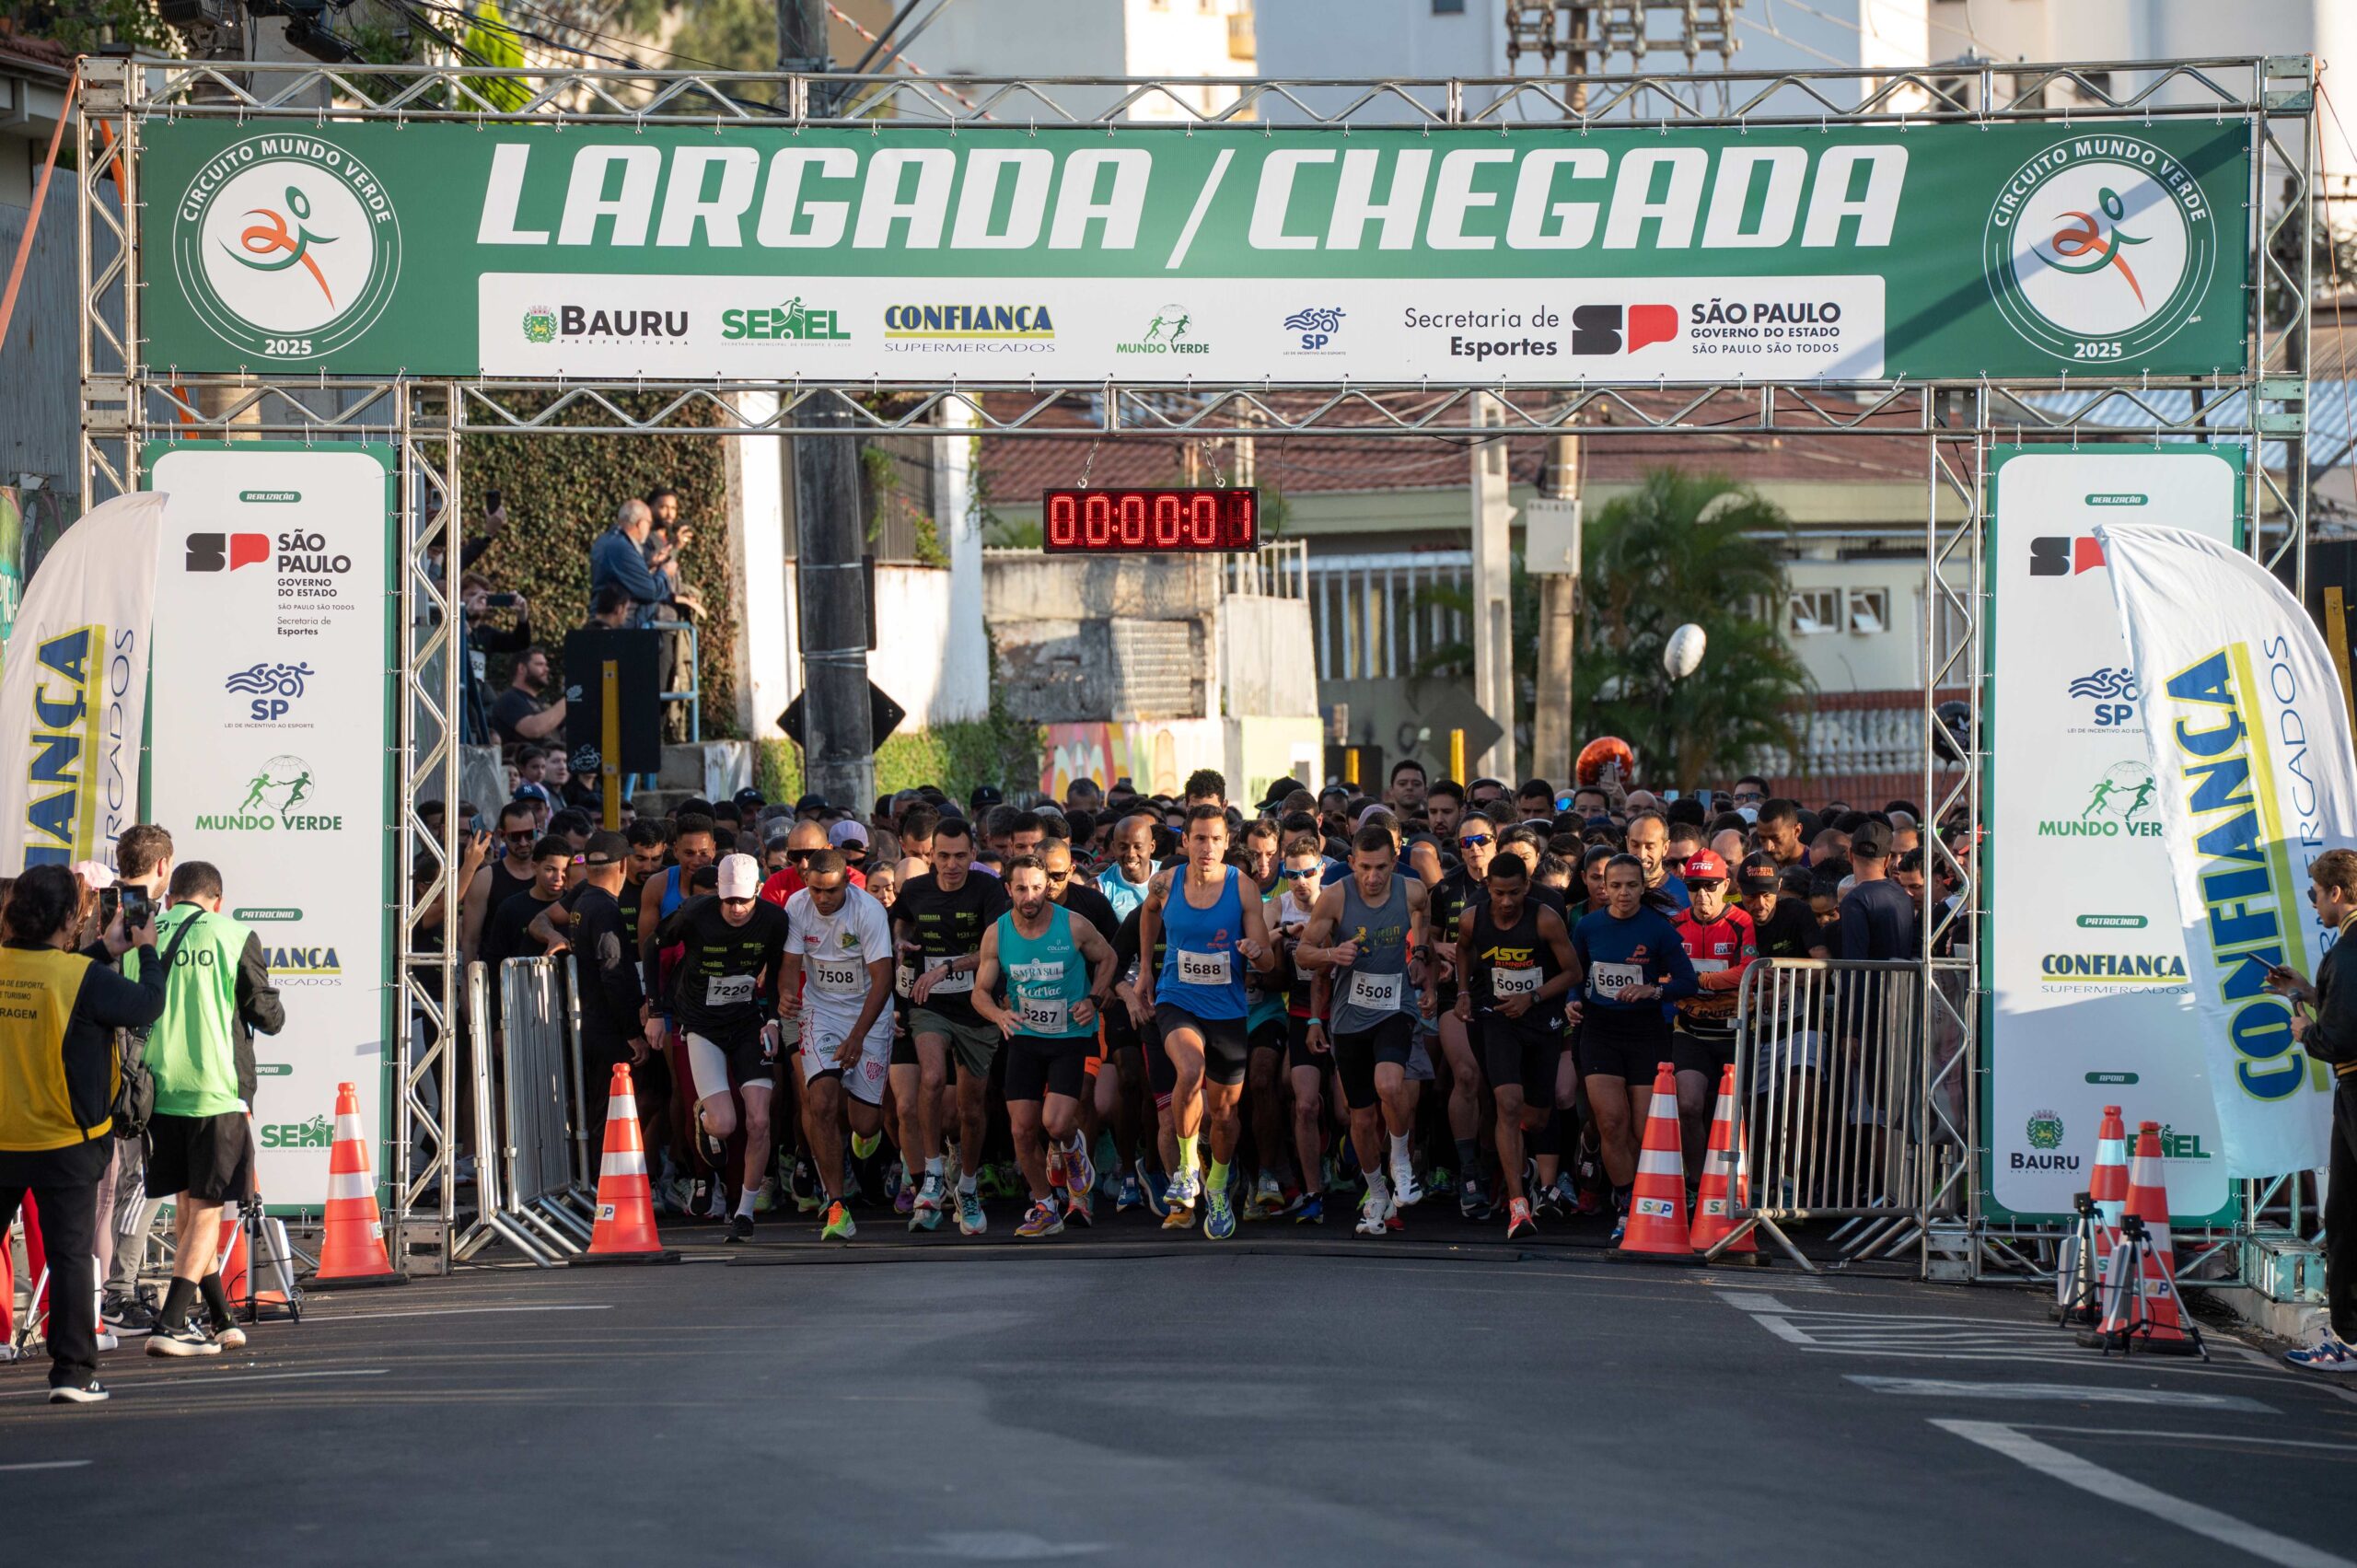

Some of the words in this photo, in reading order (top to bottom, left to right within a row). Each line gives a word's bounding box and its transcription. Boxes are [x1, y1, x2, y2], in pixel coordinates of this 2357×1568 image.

[183, 145, 253, 222] CIRCUITO
[261, 139, 341, 166] MUNDO
[344, 161, 391, 223] VERDE
[1994, 148, 2068, 226] CIRCUITO
[2075, 139, 2156, 165] MUNDO
[2159, 159, 2207, 222] VERDE
[477, 144, 1152, 249] LARGADA
[1165, 149, 1236, 269] /
[1248, 145, 1909, 250] CHEGADA
[884, 305, 1054, 333] CONFIANÇA
[1404, 307, 1517, 328] Secretaria
[1531, 307, 1559, 328] de
[1691, 299, 1747, 324] SÃO
[1754, 303, 1840, 324] PAULO
[561, 305, 688, 337] BAURU
[721, 308, 851, 340] SEMEL
[1691, 327, 1759, 338] GOVERNO
[1764, 327, 1784, 337] DO
[1789, 326, 1840, 337] ESTADO
[264, 339, 312, 354] 2025
[884, 343, 1055, 353] SUPERMERCADOS
[1116, 343, 1167, 354] MUNDO
[1172, 343, 1210, 354] VERDE
[1301, 334, 1329, 350] SP
[1451, 337, 1557, 362] Esportes
[1692, 342, 1719, 354] SÃO
[1723, 344, 1763, 354] PAULO
[1767, 341, 1793, 354] SÃO
[1796, 343, 1840, 353] TODOS
[2073, 343, 2122, 357] 2025
[246, 493, 295, 502] REALIZAÇÃO
[2092, 495, 2141, 505] REALIZAÇÃO
[278, 528, 326, 552] SÃO
[278, 555, 352, 574] PAULO
[277, 578, 331, 587] GOVERNO
[278, 588, 294, 597] DO
[297, 588, 337, 597] ESTADO
[277, 616, 318, 625] Secretaria
[320, 616, 331, 625] de
[277, 627, 318, 637] Esportes
[250, 699, 289, 721] SP
[2094, 704, 2133, 726] SP
[23, 623, 93, 874] IANÇA
[195, 815, 274, 830] MUNDO
[282, 816, 343, 830] VERDE
[2038, 820, 2119, 836] MUNDO
[2125, 821, 2164, 836] VER
[241, 910, 295, 919] PATROCÍNIO
[2085, 916, 2139, 926] PATROCÍNIO
[262, 947, 341, 969] IANÇA
[1184, 963, 1221, 975] 5688
[2041, 954, 2187, 978] CONFIANÇA
[818, 970, 853, 983] 7508
[1598, 974, 1633, 987] 5680
[714, 984, 749, 996] 7220
[1355, 982, 1392, 999] 5508
[1497, 978, 1534, 992] 5090
[2041, 984, 2189, 995] SUPERMERCADOS
[0, 1007, 37, 1020] RAGEM
[1024, 1007, 1058, 1023] 5287
[2011, 1153, 2080, 1169] BAURU
[1643, 1201, 1672, 1214] SAP
